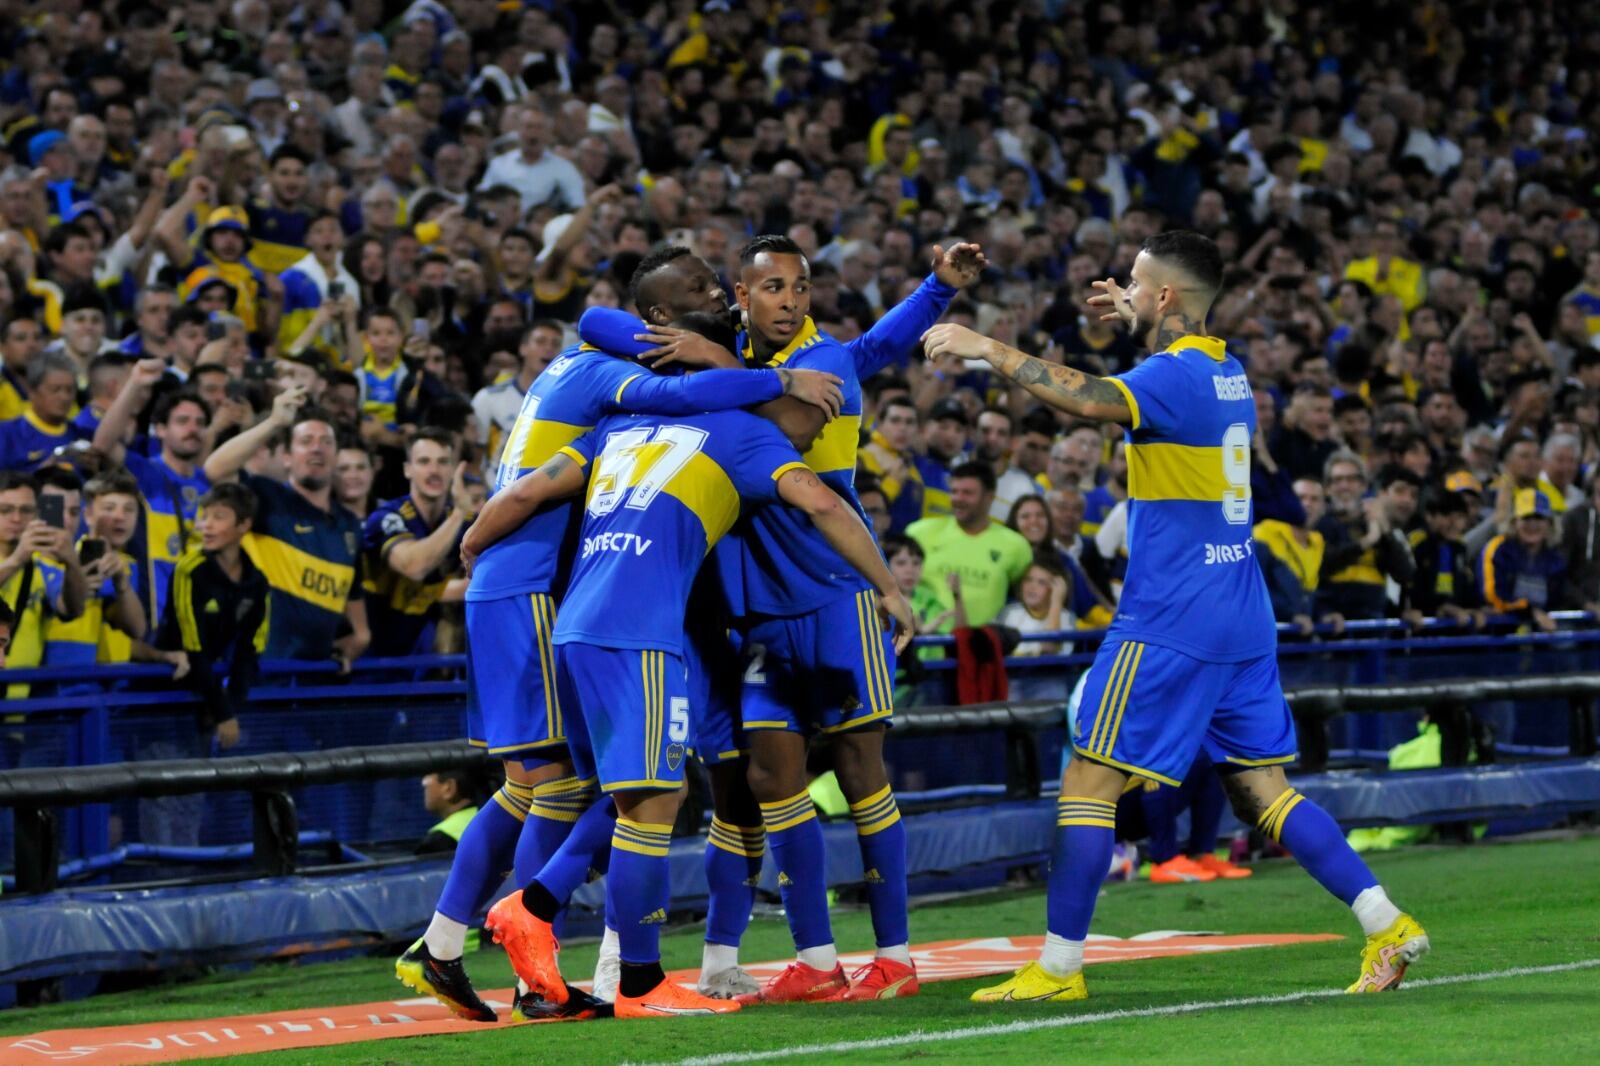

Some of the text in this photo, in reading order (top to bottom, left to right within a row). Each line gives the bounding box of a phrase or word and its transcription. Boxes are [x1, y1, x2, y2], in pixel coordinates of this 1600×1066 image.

[588, 424, 710, 519] 57
[1222, 422, 1252, 525] 9
[743, 642, 767, 684] 2
[668, 695, 690, 743] 5
